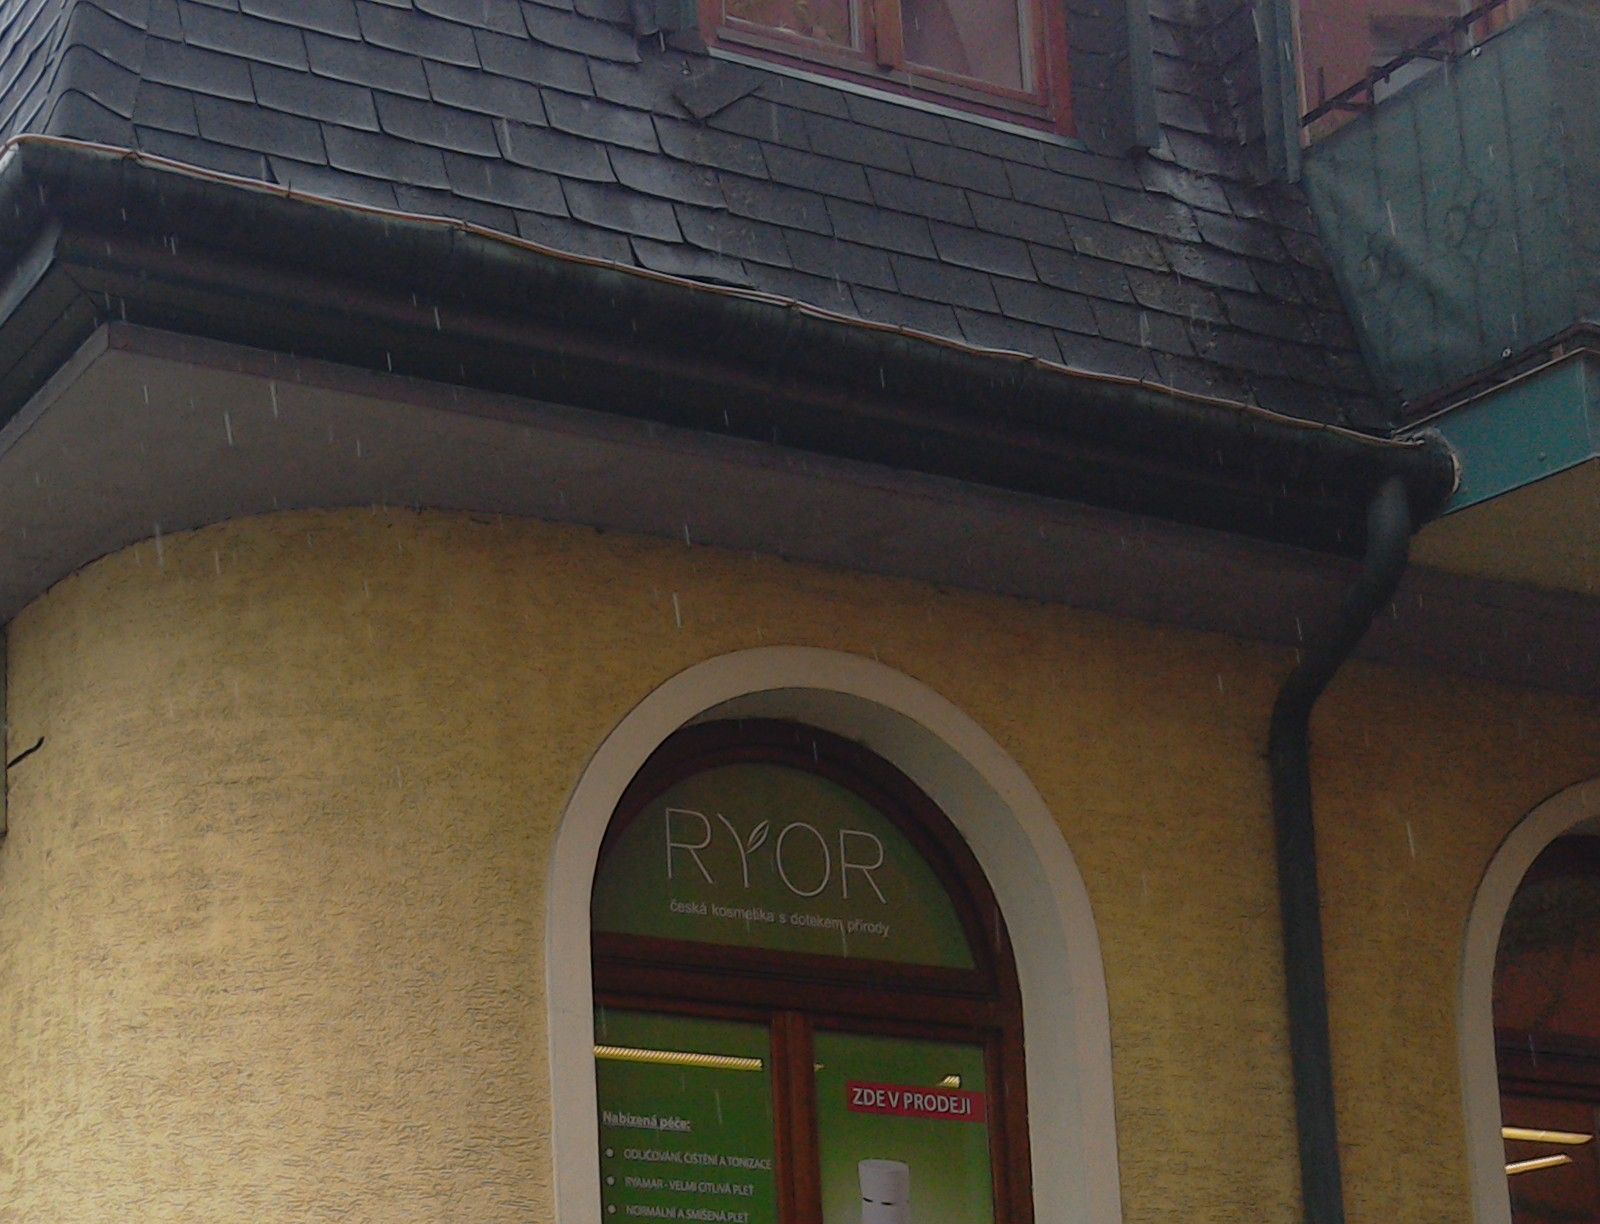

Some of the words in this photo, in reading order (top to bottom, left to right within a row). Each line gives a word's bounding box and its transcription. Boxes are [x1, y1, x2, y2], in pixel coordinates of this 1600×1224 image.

[664, 806, 888, 905] RYOR
[669, 896, 708, 916] česká
[711, 903, 776, 924] kosmetika
[779, 912, 788, 925] s
[852, 1087, 886, 1107] ZDE
[887, 1090, 900, 1108] V
[902, 1092, 972, 1114] PRODEJI
[726, 1157, 773, 1170] TONIZACE
[669, 1181, 697, 1192] VELMI
